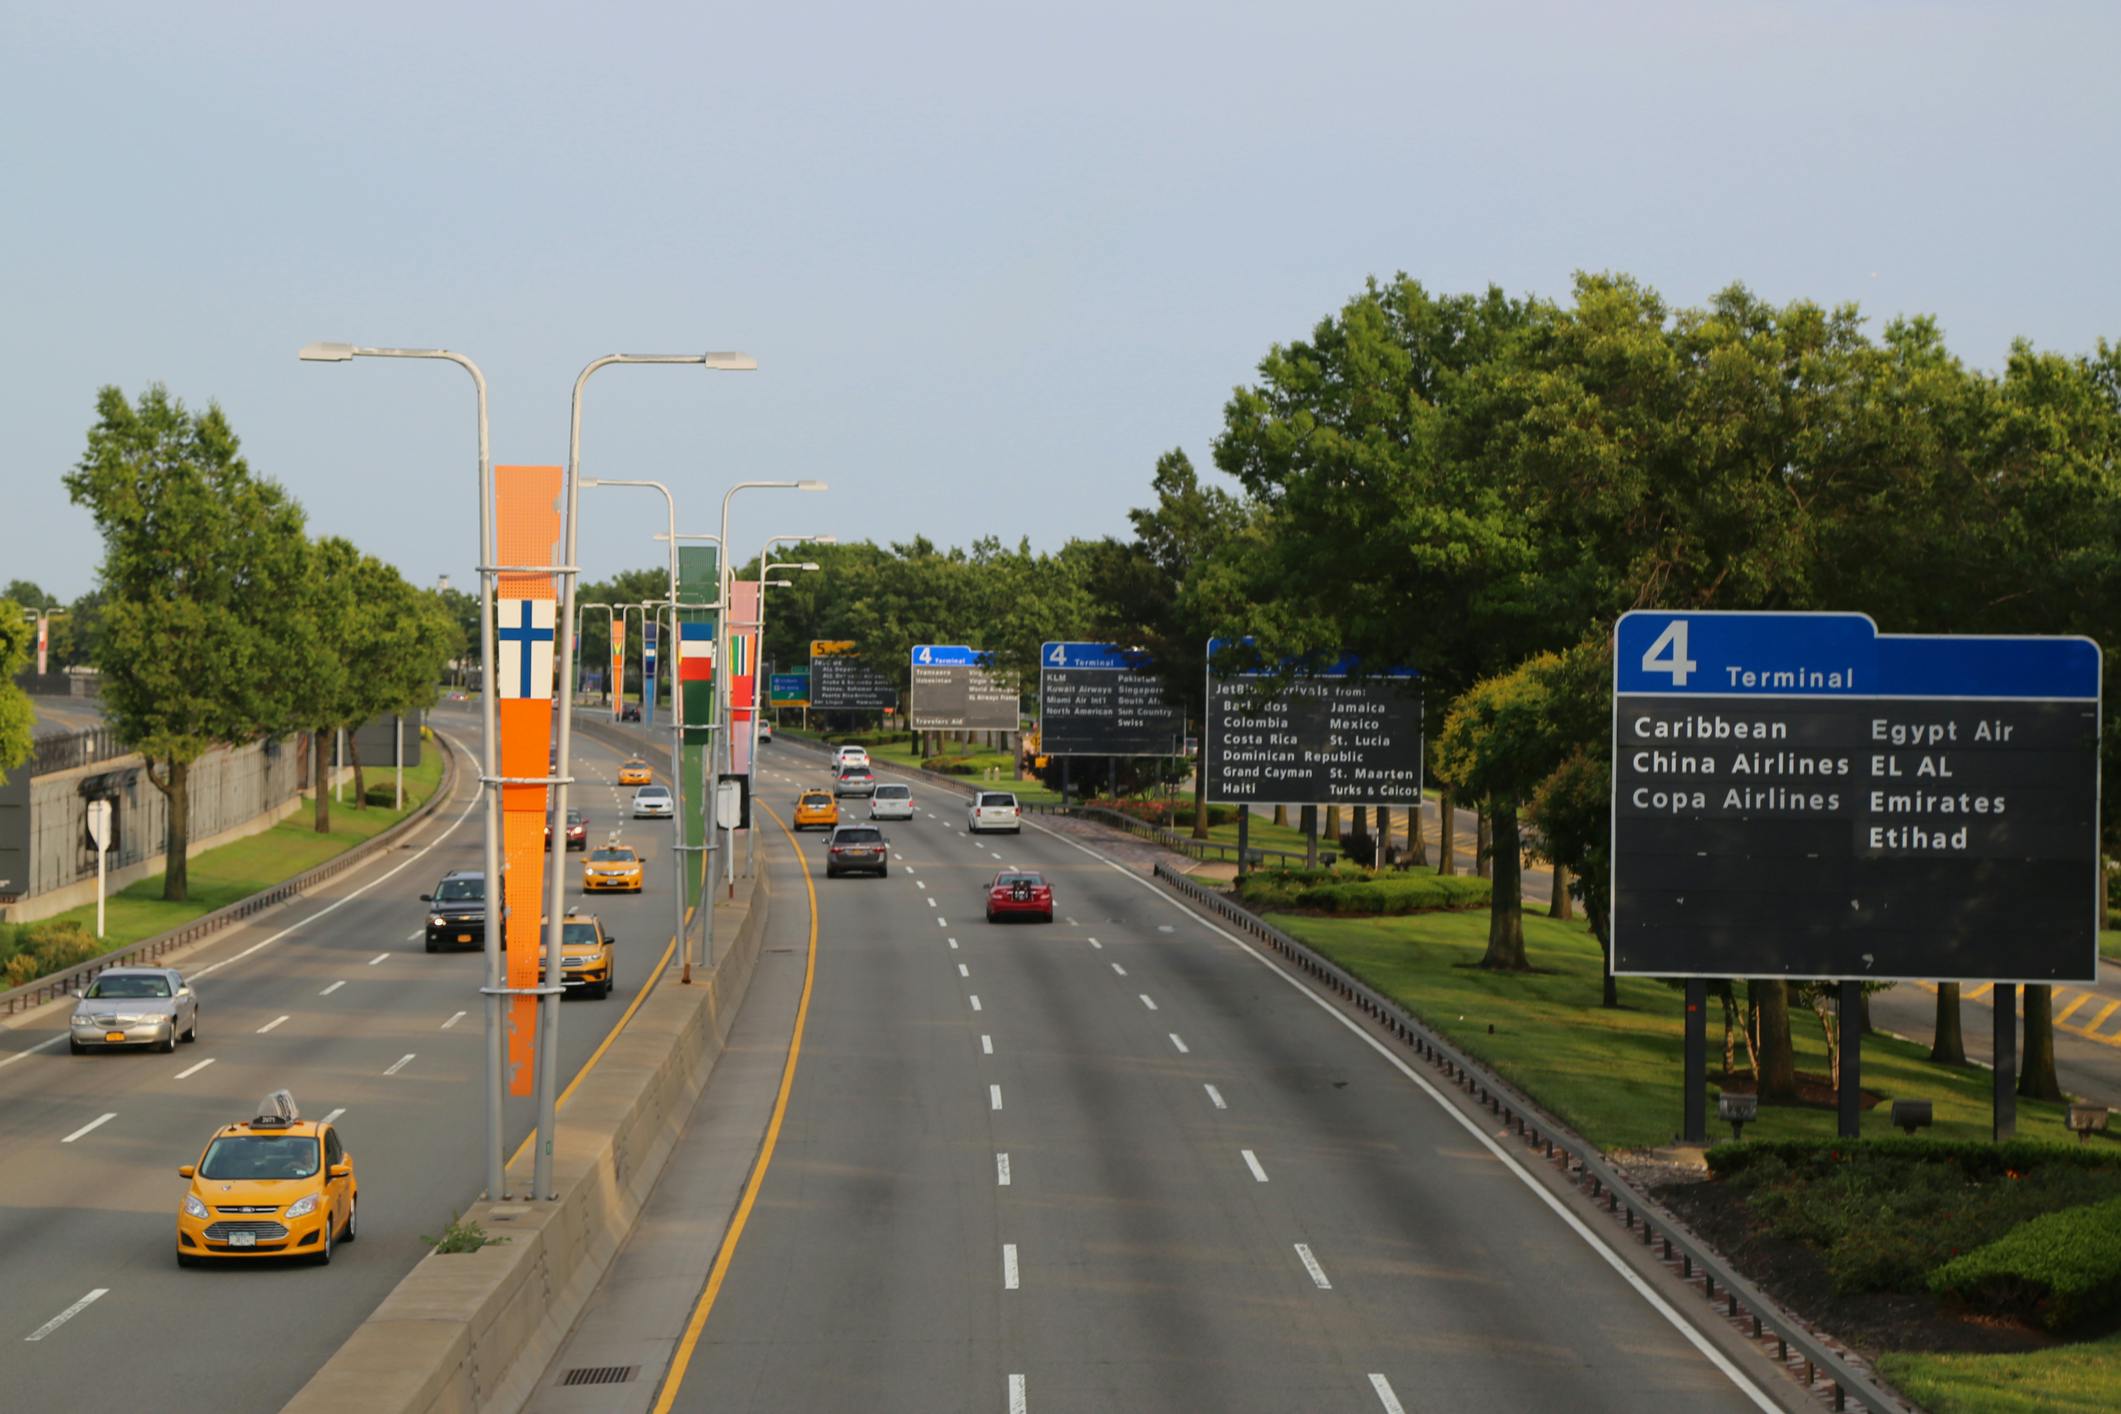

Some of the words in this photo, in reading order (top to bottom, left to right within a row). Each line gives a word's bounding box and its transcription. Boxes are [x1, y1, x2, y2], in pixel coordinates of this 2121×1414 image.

[817, 643, 825, 655] 5
[1642, 620, 1696, 685] 4
[919, 648, 932, 663] 4
[1050, 645, 1067, 666] 4
[1047, 674, 1066, 682] KLM
[1726, 667, 1852, 688] Terminal
[1079, 686, 1112, 695] Airways
[1336, 687, 1366, 697] from:
[1047, 707, 1070, 715] North
[1138, 708, 1172, 717] Country
[1331, 702, 1384, 712] Jamaica
[1118, 719, 1143, 727] Swiss
[1224, 717, 1287, 727] Colombia
[1330, 719, 1378, 729] Mexico
[1635, 716, 1786, 738] Caribbean
[1224, 734, 1262, 744] Costa
[1270, 733, 1297, 744] Rica
[1873, 720, 1956, 745] Egypt
[1975, 721, 2013, 741] Air
[1330, 735, 1347, 745] St.
[1356, 736, 1389, 746] Lucia
[1224, 750, 1294, 761] Dominican
[1305, 751, 1362, 764] Republic
[1633, 751, 1714, 773] China
[1732, 753, 1848, 774] Airlines
[1872, 756, 1902, 776] EL
[1917, 756, 1952, 776] AL
[1223, 766, 1259, 776] Grand
[1265, 767, 1312, 780] Cayman
[1330, 768, 1347, 778] St.
[1355, 768, 1412, 779] Maarten
[1223, 783, 1255, 793] Haiti
[1330, 784, 1361, 795] Turks
[1368, 787, 1374, 795] &
[1381, 785, 1417, 796] Caicos
[1633, 788, 1705, 813] Copa
[1723, 788, 1839, 810] Airlines
[1871, 791, 2004, 813] Emirates
[1870, 827, 1966, 849] Etihad
